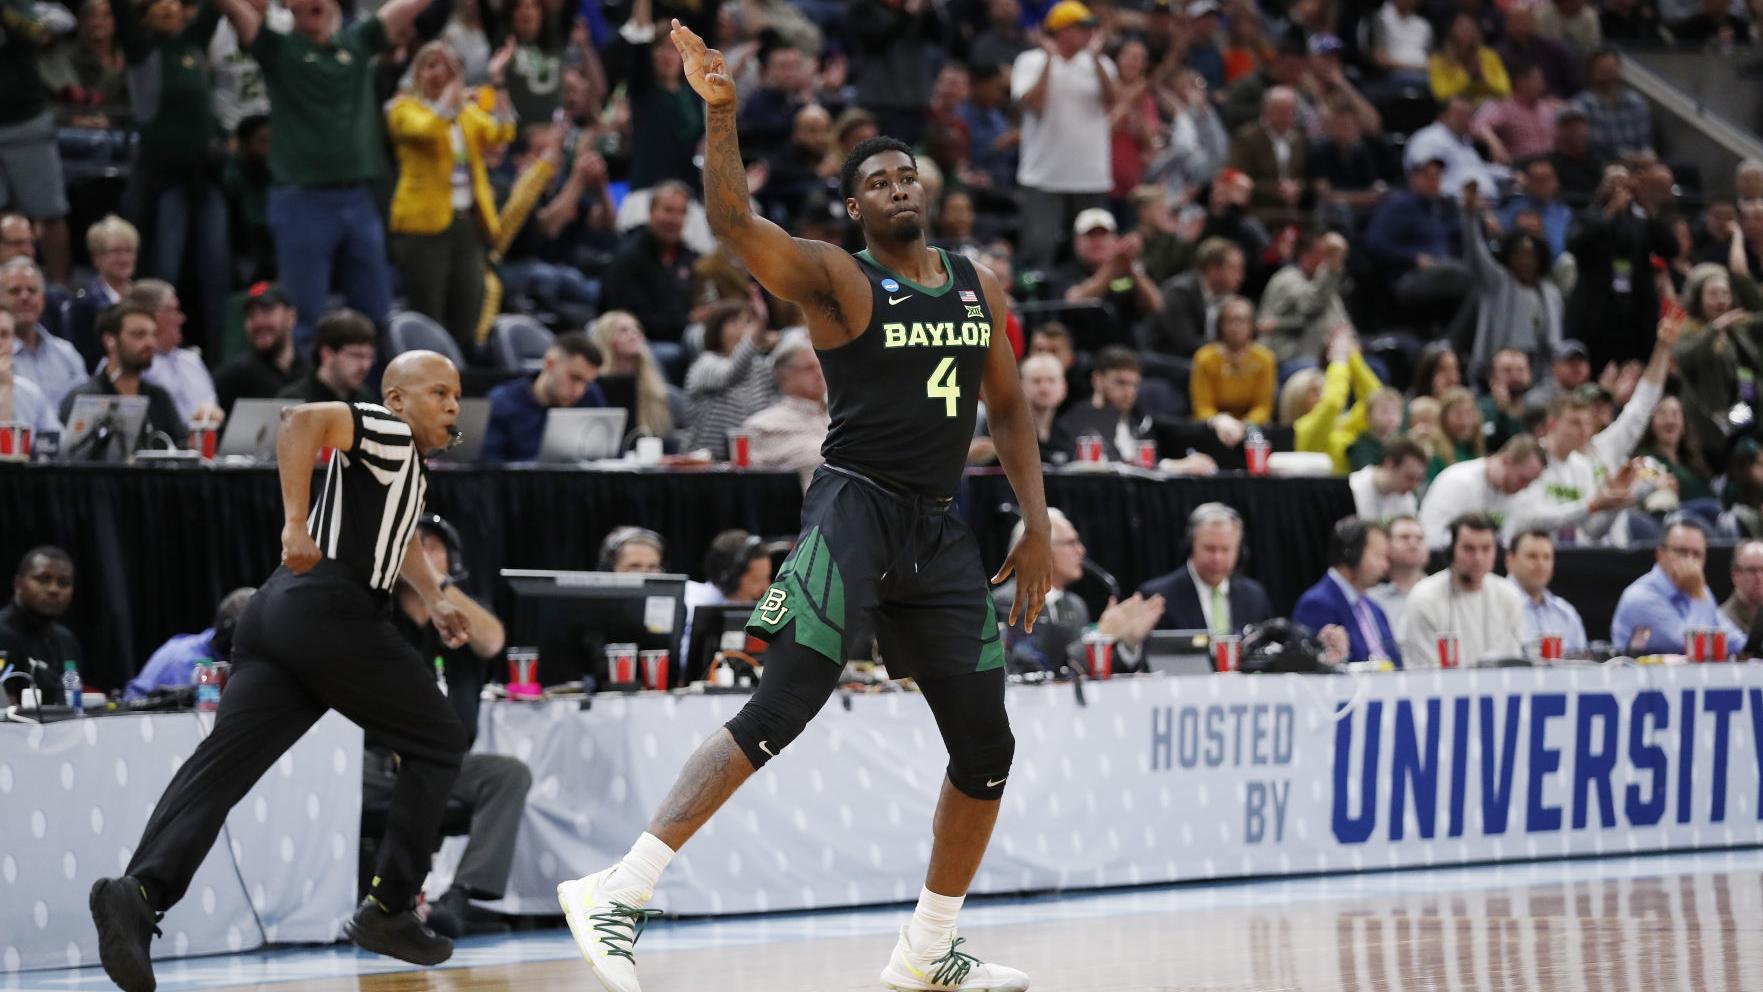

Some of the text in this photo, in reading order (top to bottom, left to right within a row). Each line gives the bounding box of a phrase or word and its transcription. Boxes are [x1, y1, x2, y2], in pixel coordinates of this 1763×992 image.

[883, 321, 992, 348] BAYLOR
[926, 356, 961, 417] 4
[759, 587, 789, 625] BU
[1151, 702, 1295, 772] HOSTED
[1245, 780, 1290, 844] BY
